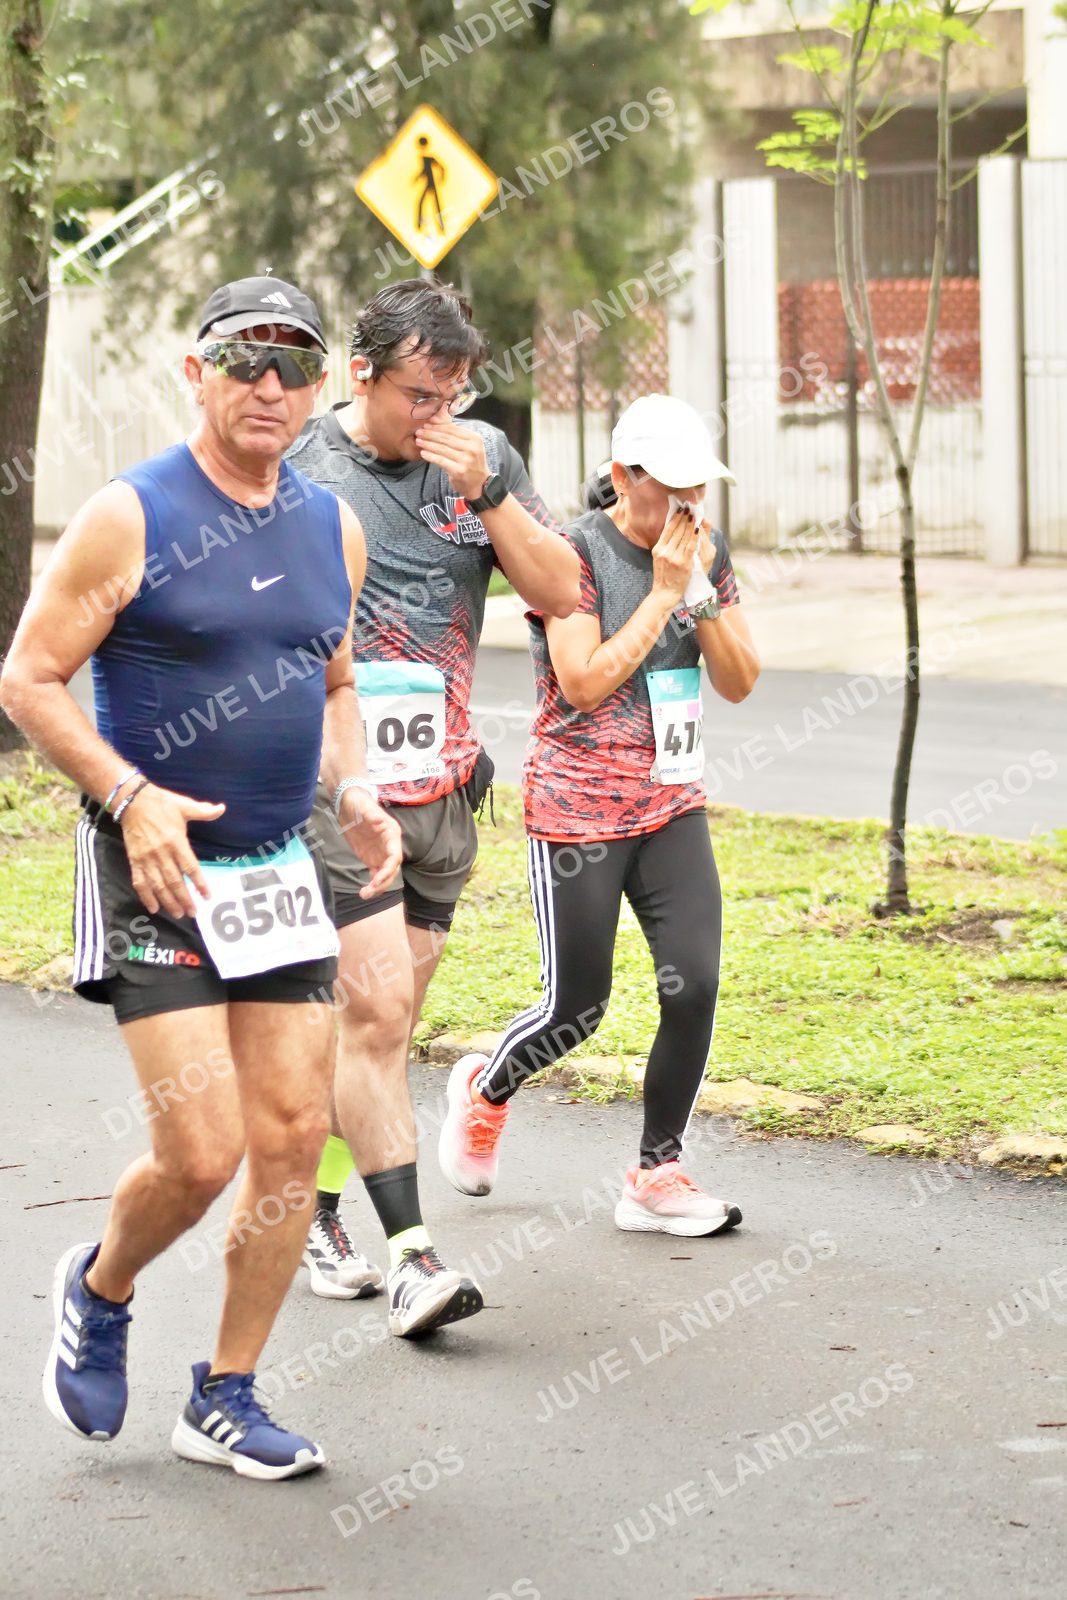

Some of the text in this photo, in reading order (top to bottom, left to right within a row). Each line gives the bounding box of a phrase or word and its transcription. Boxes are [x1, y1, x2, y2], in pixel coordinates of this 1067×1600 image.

[363, 713, 436, 752] 06
[664, 714, 703, 756] 41
[211, 886, 320, 943] 6502
[128, 942, 201, 966] MÉXICO
